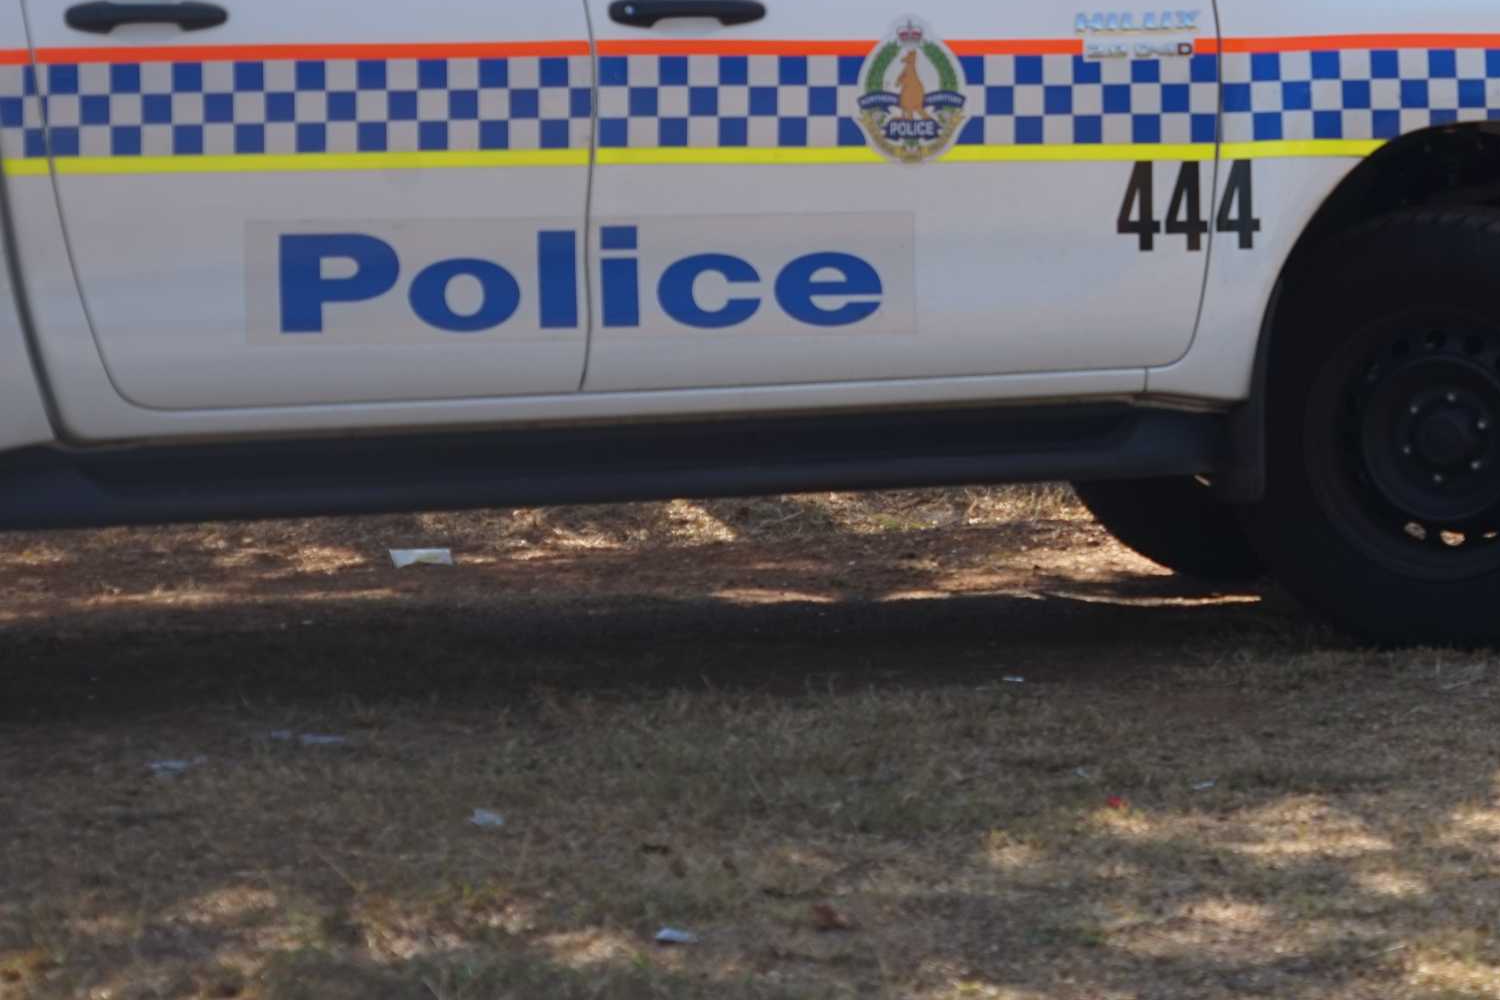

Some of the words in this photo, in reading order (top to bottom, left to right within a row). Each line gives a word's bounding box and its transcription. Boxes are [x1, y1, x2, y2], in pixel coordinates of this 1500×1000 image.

[889, 121, 934, 137] POLICE
[1117, 159, 1261, 251] 444
[279, 225, 883, 334] Police
